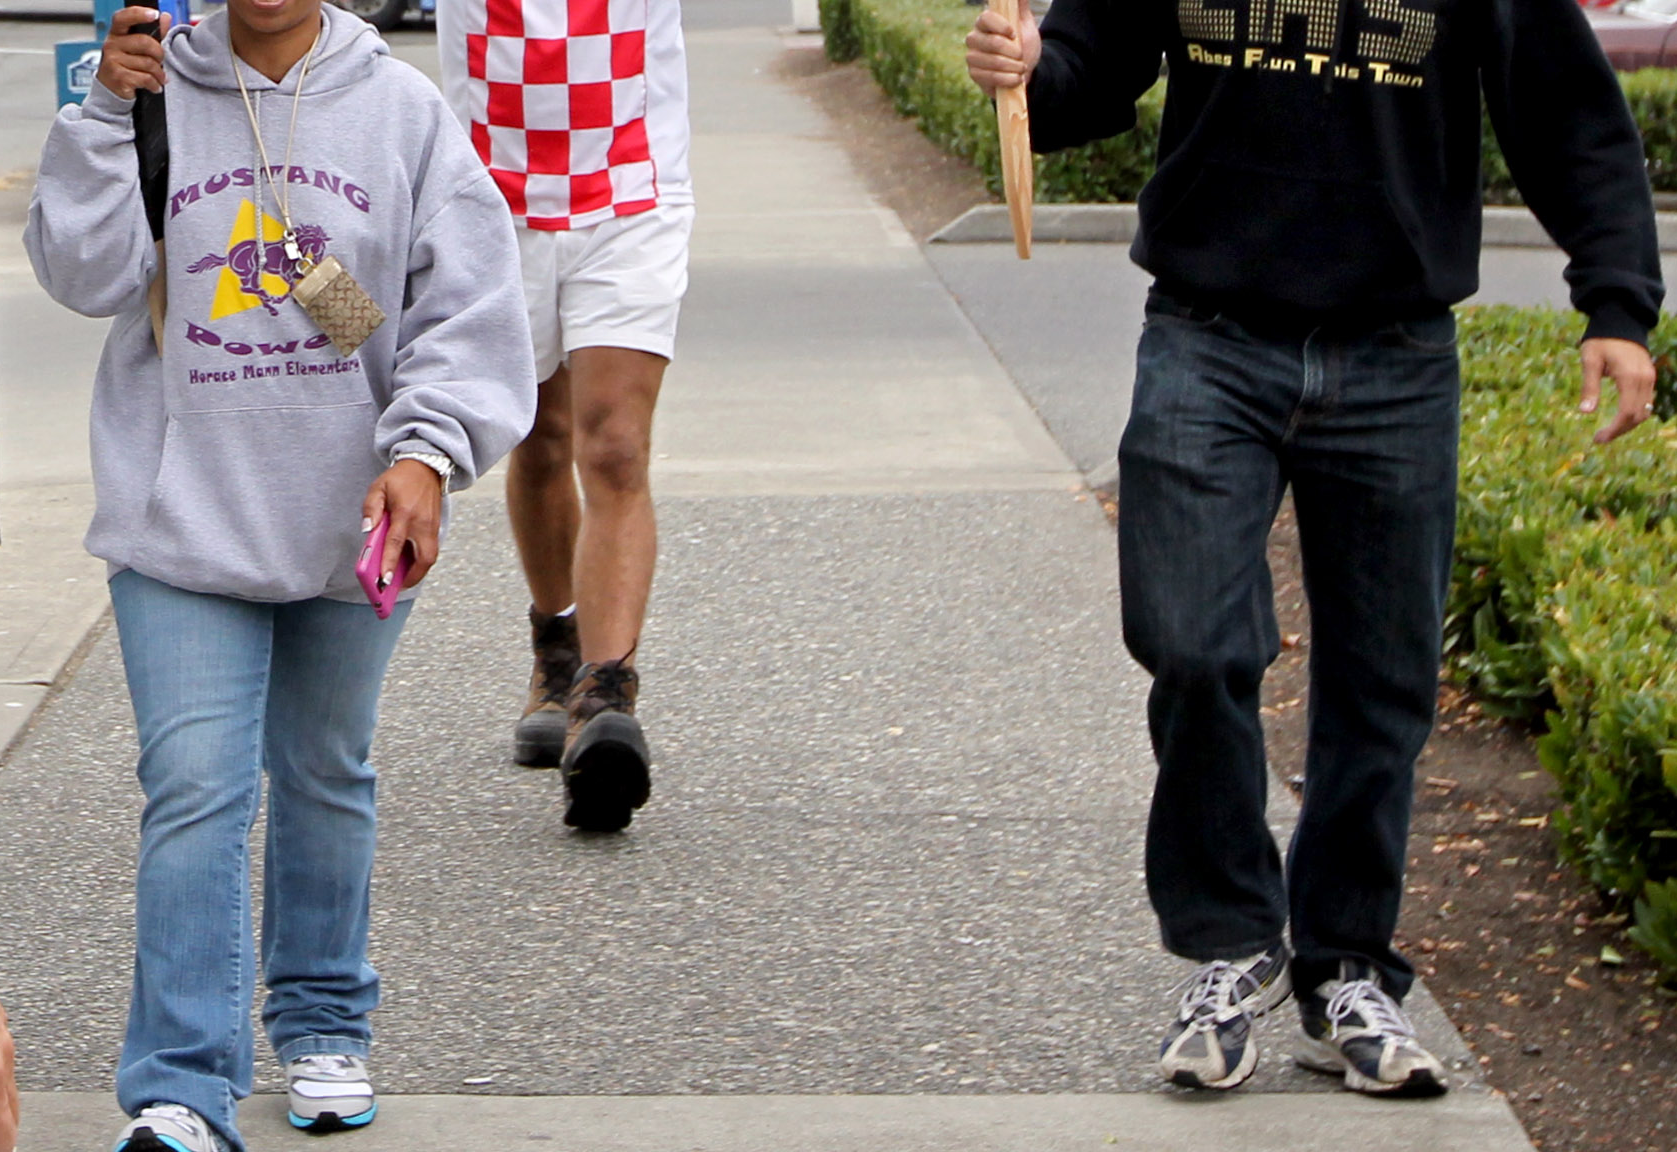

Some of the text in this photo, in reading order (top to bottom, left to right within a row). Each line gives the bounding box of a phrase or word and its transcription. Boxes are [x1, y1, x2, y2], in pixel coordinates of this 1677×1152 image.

[1187, 43, 1232, 66] Abes
[1368, 62, 1423, 88] Town
[170, 165, 370, 220] MUSTANG
[189, 358, 360, 384] Horace Mann Elementary
